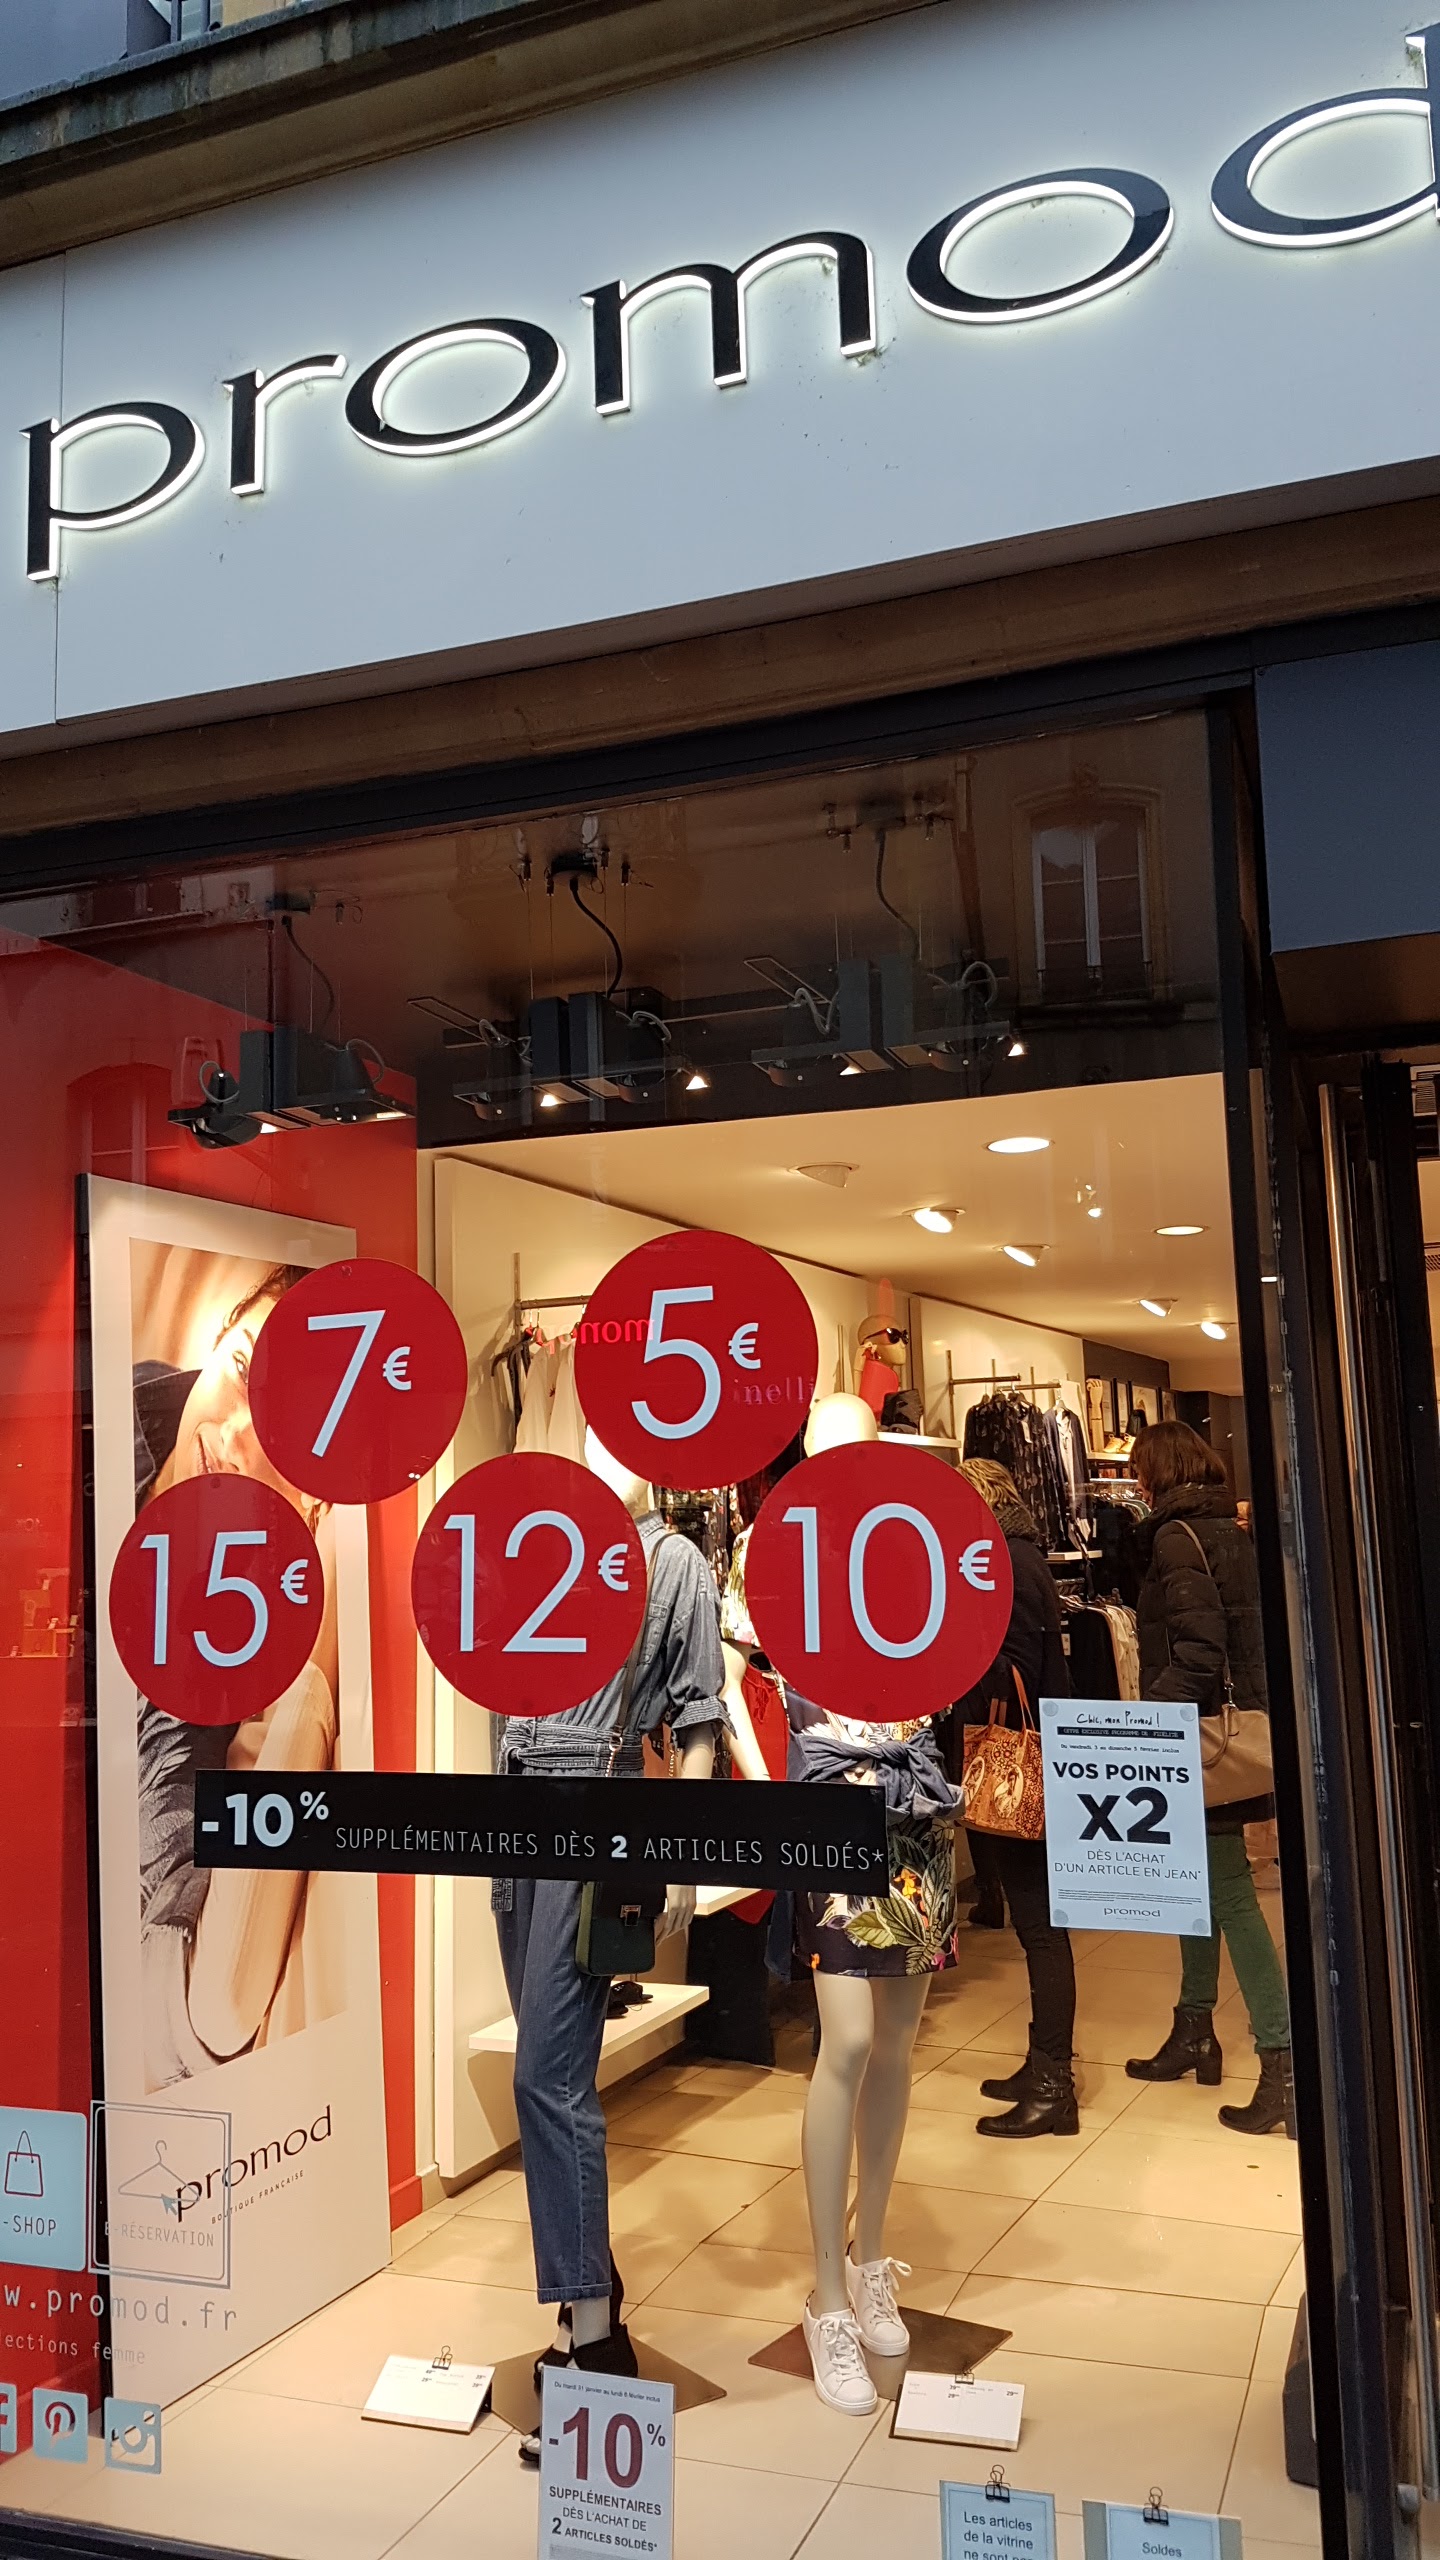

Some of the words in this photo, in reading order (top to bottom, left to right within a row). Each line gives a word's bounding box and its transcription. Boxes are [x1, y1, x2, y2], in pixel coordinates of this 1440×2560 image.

[21, 22, 1440, 582] promod
[630, 1285, 761, 1440] 5€
[306, 1309, 413, 1458] 7€
[443, 1509, 630, 1653] 12€
[781, 1502, 996, 1659] 10€
[139, 1530, 309, 1668] 15€
[1052, 1761, 1099, 1780] VOS
[1105, 1763, 1190, 1784] POINTS
[201, 1790, 330, 1848] -10%
[334, 1824, 539, 1856] SUPPLÉMENTAIRES
[553, 1830, 596, 1858] DÈS
[610, 1834, 628, 1859] 2
[643, 1837, 764, 1864] ARTICLES
[1054, 1862, 1084, 1874] D'UN
[1087, 1864, 1140, 1877] ARTICLE
[1143, 1867, 1161, 1878] EN
[1087, 1848, 1112, 1861] DÈS
[1115, 1852, 1166, 1864] L'ACHAT
[1103, 1907, 1161, 1917] promod
[176, 2104, 332, 2224] promod
[92, 2341, 146, 2365] femme
[548, 2406, 667, 2489] -10%
[549, 2485, 662, 2516] SUPPLÉMENTAIRES
[551, 2516, 563, 2535] 2
[564, 2527, 612, 2545] ARTICLES
[586, 2510, 630, 2528] L'ACHAT
[632, 2519, 647, 2532] DE
[963, 2511, 986, 2525] Les
[989, 2516, 1033, 2532] articles
[963, 2530, 979, 2542] de
[982, 2531, 993, 2544] la
[996, 2534, 1034, 2550] vitrine
[1142, 2541, 1182, 2558] Soldes
[963, 2550, 979, 2560] ne
